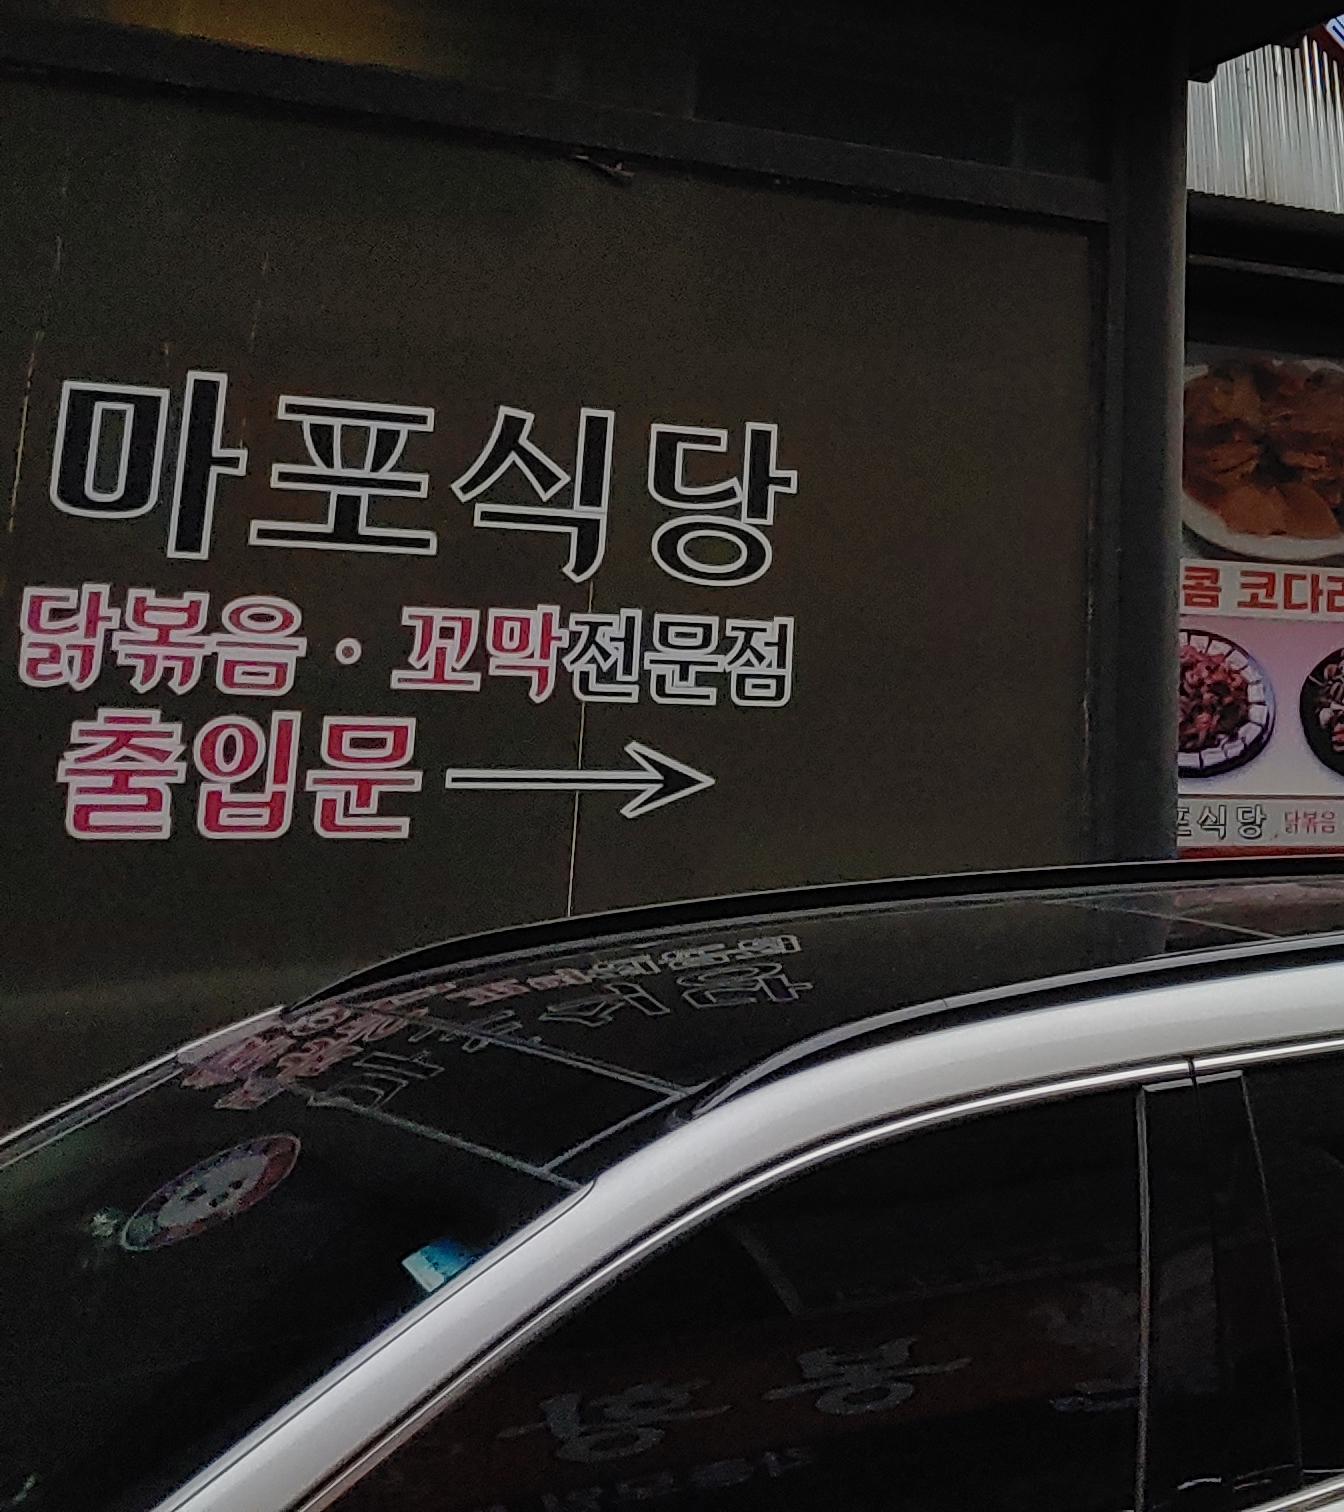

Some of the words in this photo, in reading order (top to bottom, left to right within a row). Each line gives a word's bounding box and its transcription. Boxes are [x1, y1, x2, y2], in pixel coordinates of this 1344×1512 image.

[48, 369, 799, 588] 마포식당
[18, 582, 308, 696] 닭볶음
[390, 603, 796, 707] 꼬막전문점
[56, 707, 424, 841] 출입문
